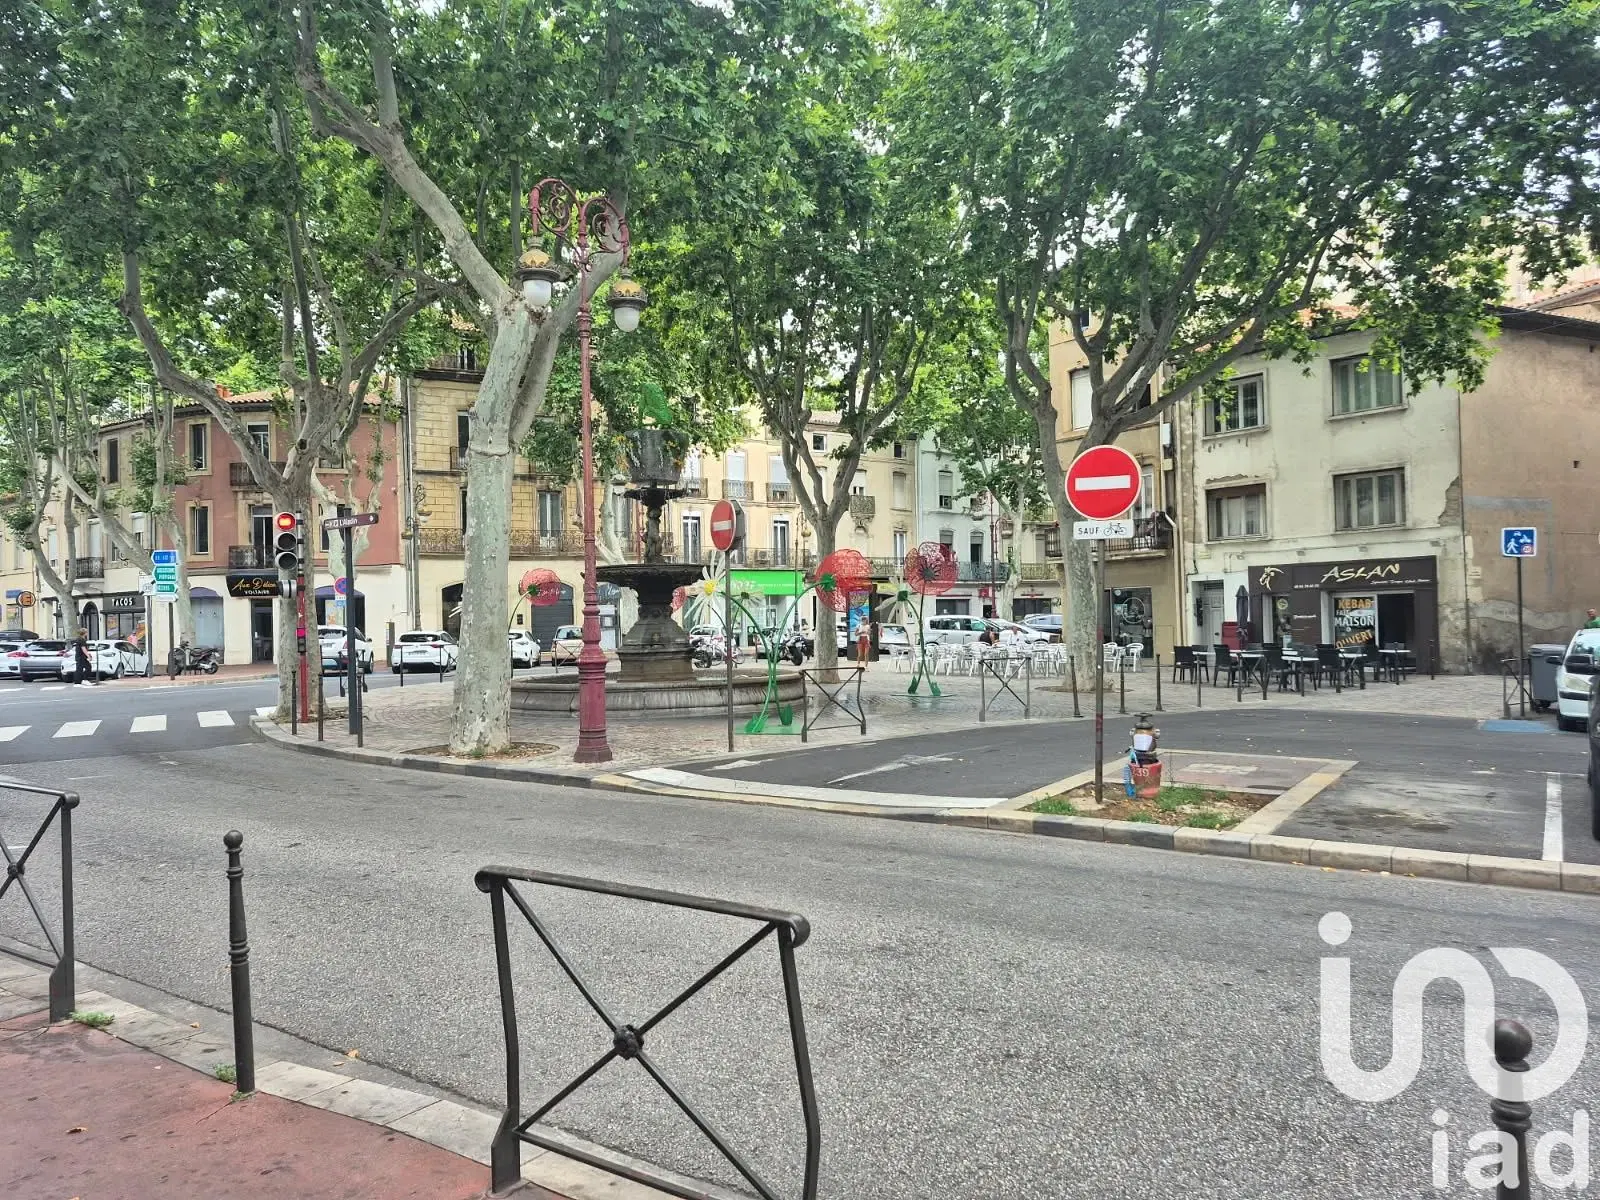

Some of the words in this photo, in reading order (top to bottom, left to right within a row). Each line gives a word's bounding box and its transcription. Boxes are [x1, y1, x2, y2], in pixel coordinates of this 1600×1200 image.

[1078, 526, 1100, 535] SAUF
[1320, 563, 1400, 583] ASLAN
[231, 578, 250, 591] Aux
[111, 597, 134, 607] TACOS
[1338, 598, 1373, 609] KEBAB
[1334, 615, 1375, 627] MAISON
[1335, 629, 1374, 650] OUVERT
